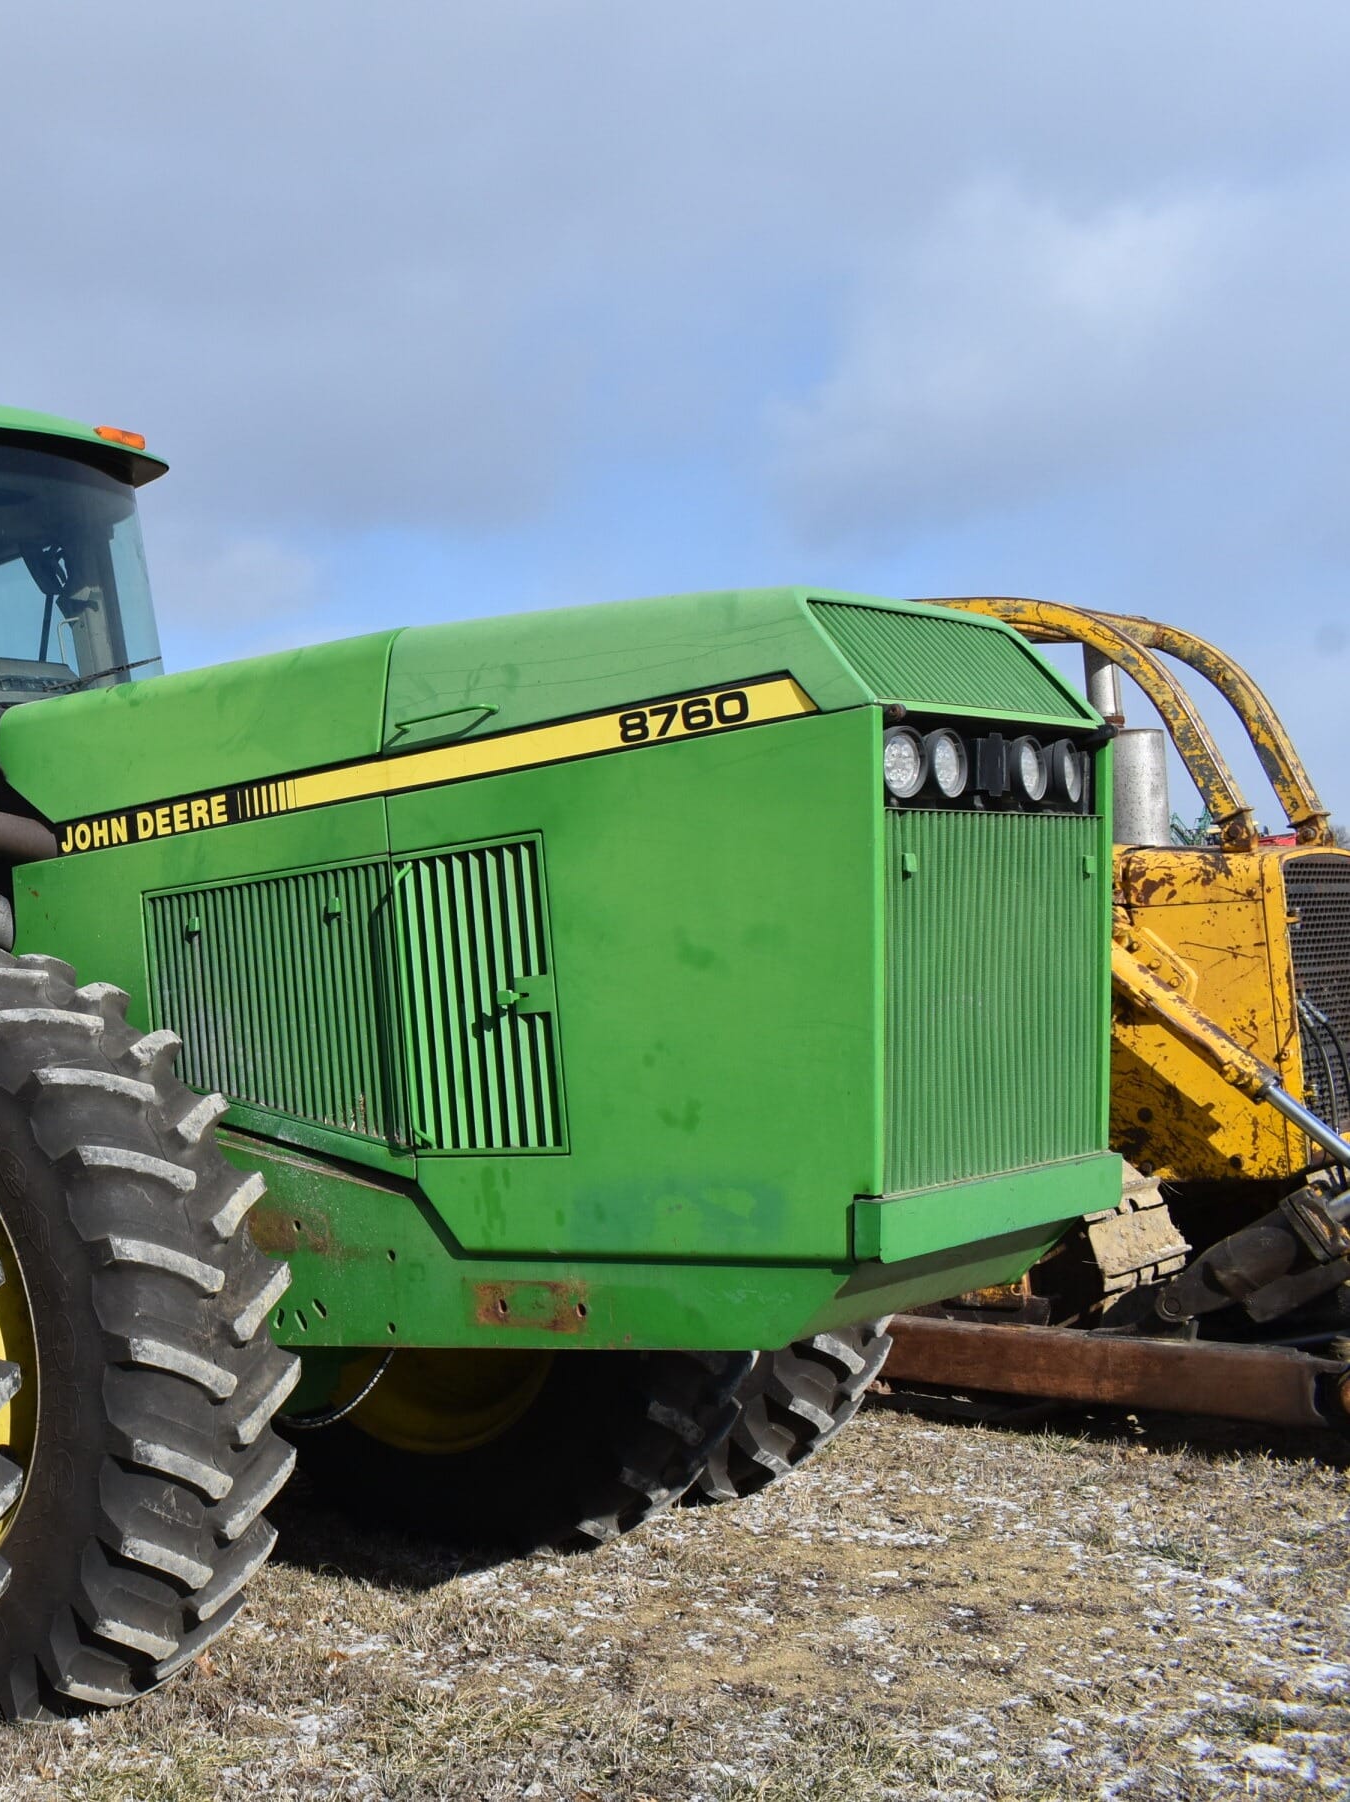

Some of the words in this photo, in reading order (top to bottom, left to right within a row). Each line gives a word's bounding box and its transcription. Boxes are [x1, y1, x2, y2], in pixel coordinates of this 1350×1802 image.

[619, 691, 749, 744] 8760
[61, 815, 129, 853] JOHN
[136, 793, 229, 840] DEERE
